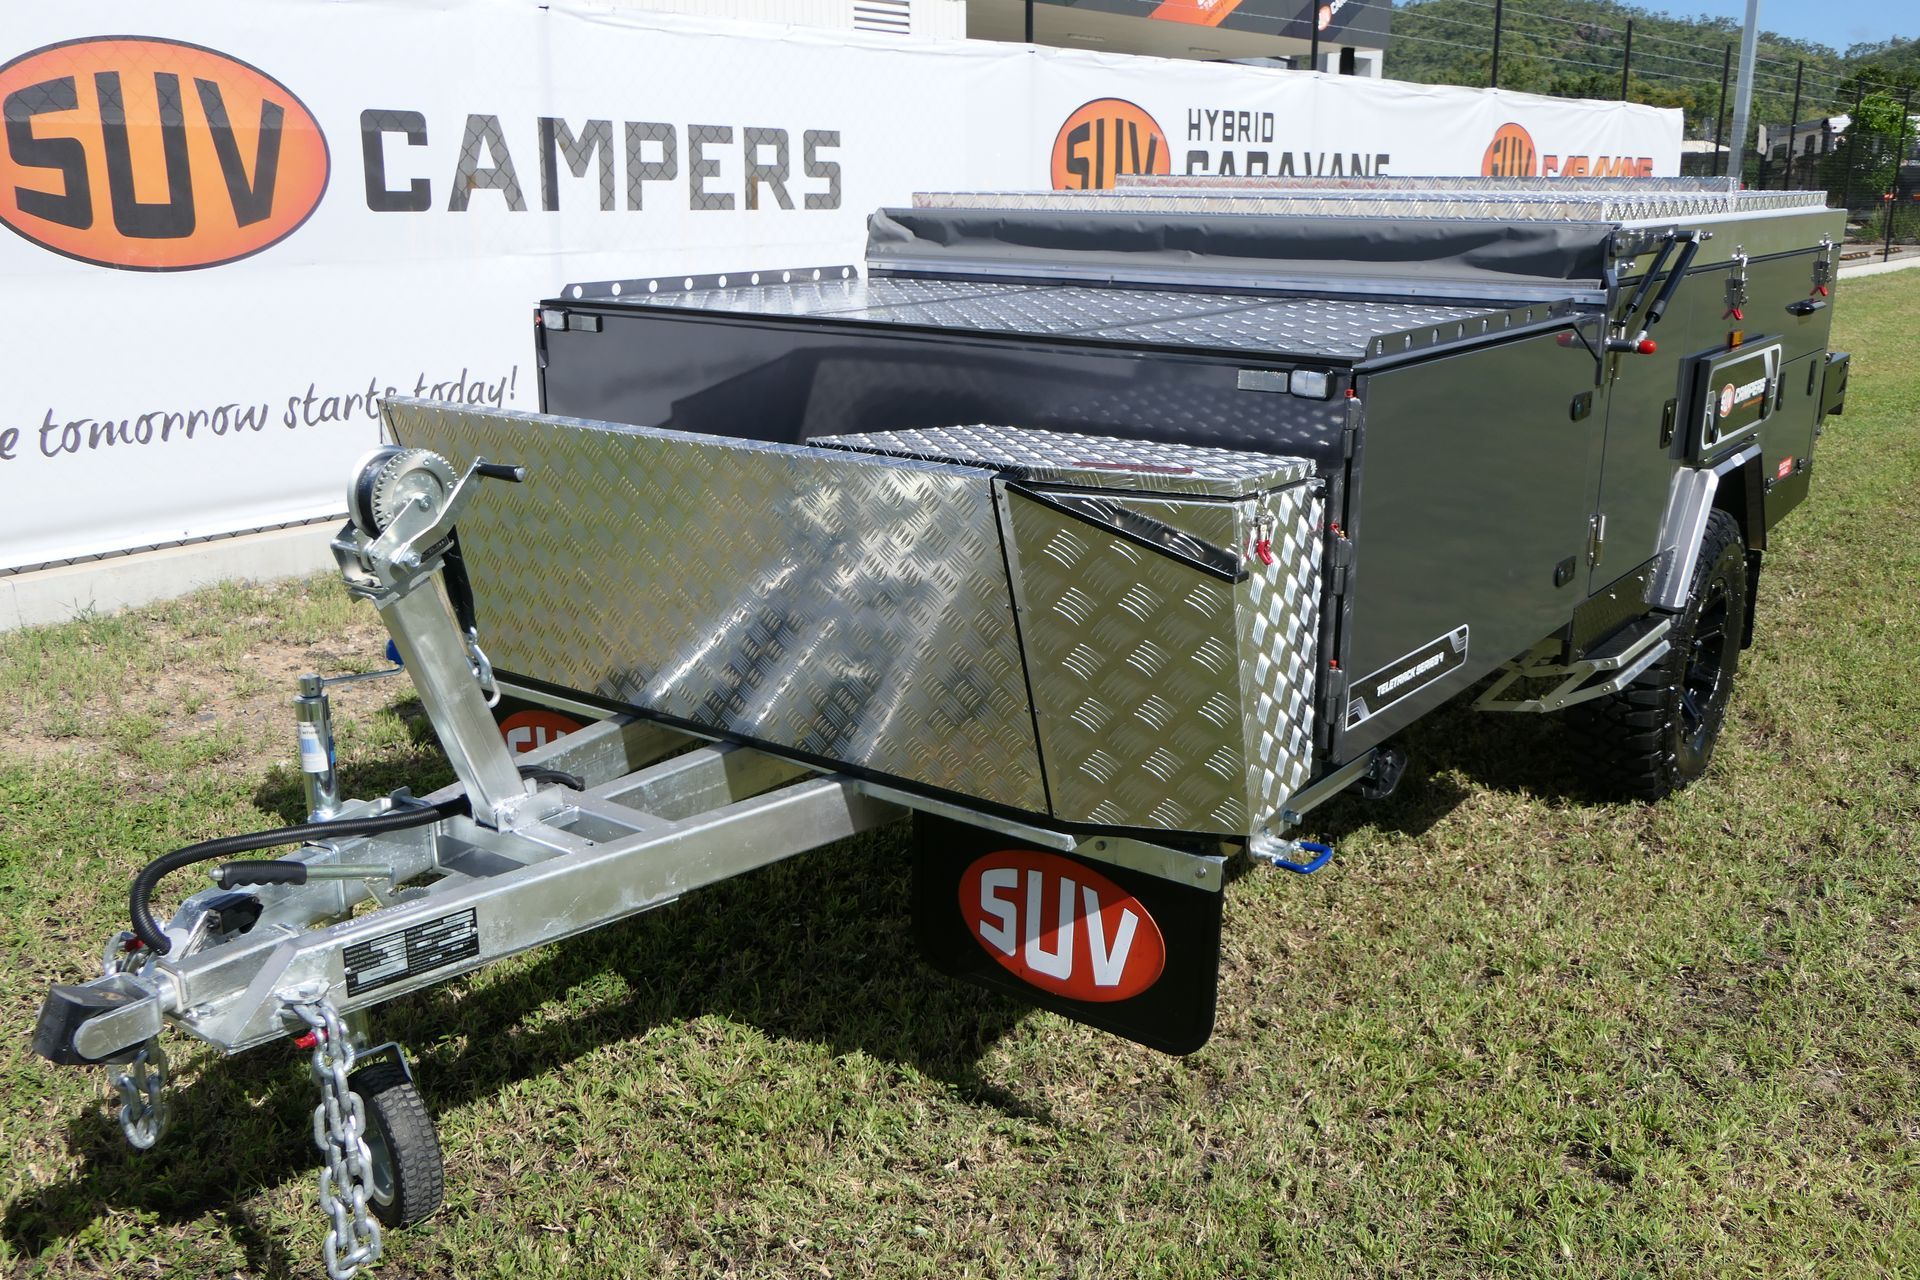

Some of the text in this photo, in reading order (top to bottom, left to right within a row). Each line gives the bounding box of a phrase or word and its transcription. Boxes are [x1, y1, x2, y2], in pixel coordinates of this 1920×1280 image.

[2, 70, 841, 239] SUV CAMPERS
[1188, 108, 1275, 143] HYBRID
[38, 407, 269, 458] tomorrow
[414, 365, 518, 408] today!
[979, 868, 1140, 987] SUV
